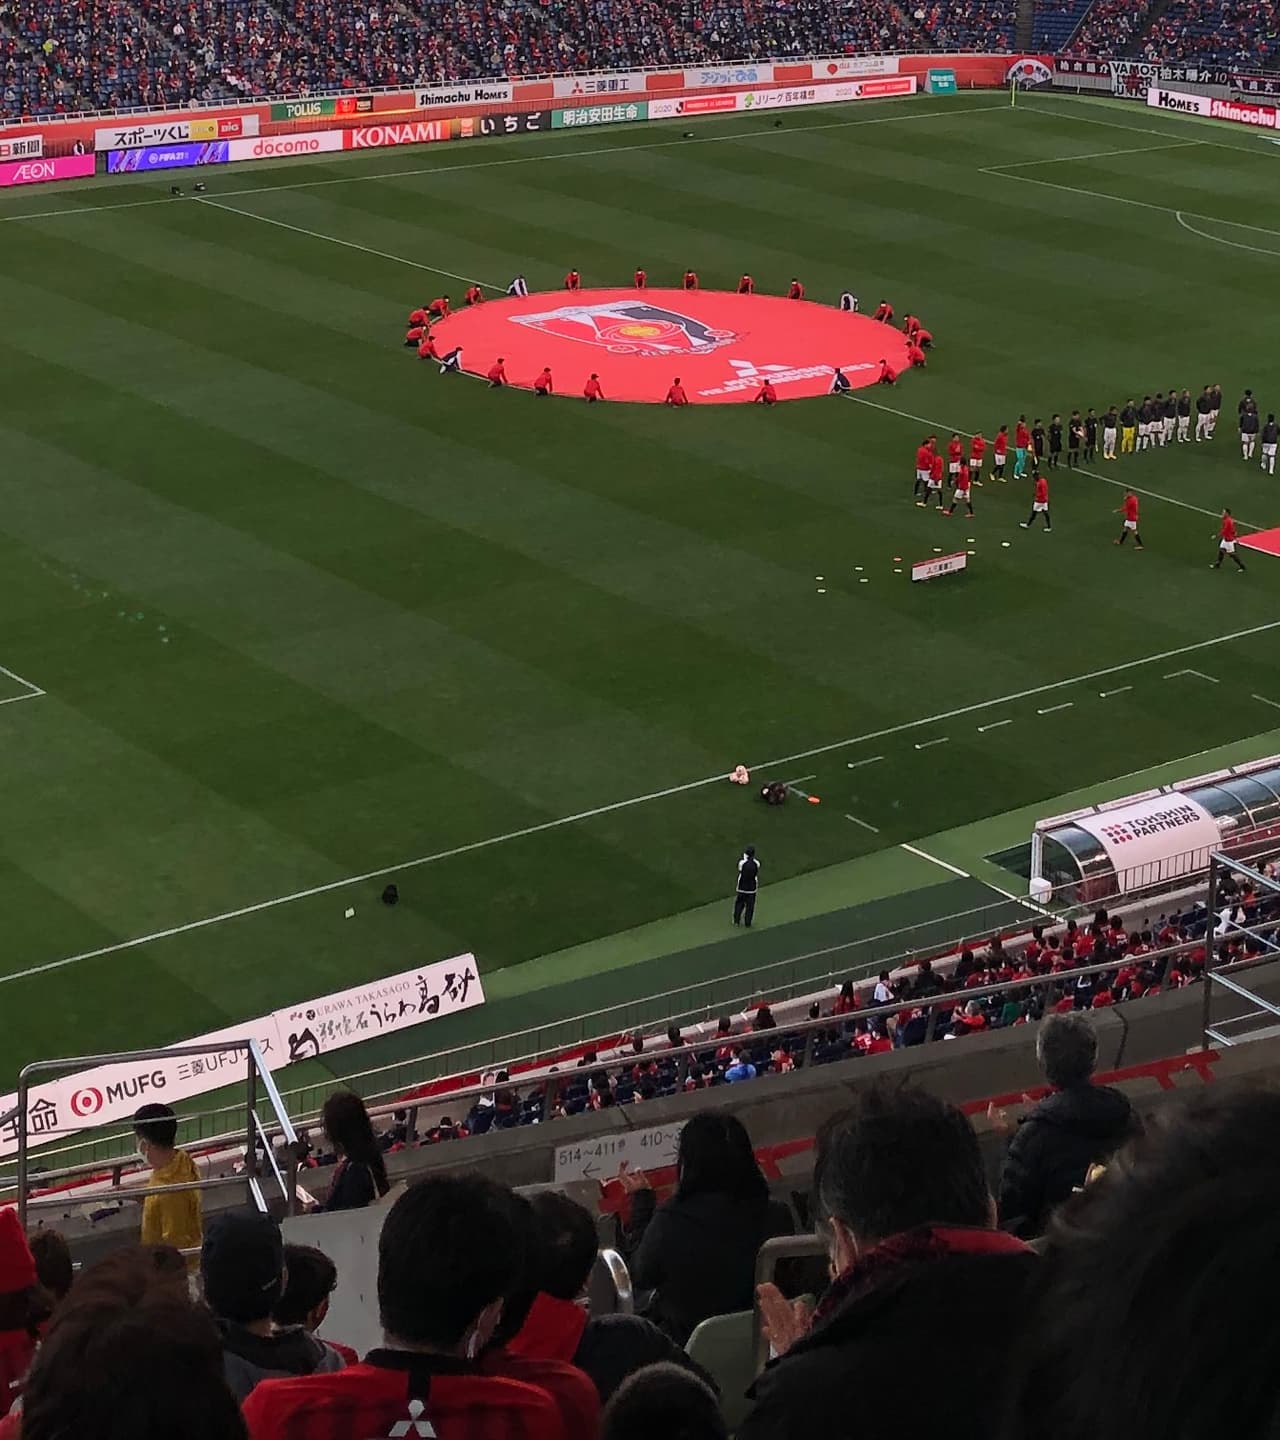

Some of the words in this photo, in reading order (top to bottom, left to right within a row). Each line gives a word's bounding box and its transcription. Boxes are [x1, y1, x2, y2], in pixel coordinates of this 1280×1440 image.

[1111, 62, 1158, 77] VAMOS
[1215, 71, 1227, 84] 10
[584, 77, 630, 93] 三菱重工
[420, 91, 471, 106] Shimachu
[286, 102, 322, 118] POLUS
[562, 104, 638, 125] 明治安田生命
[1210, 100, 1276, 127] Shimachu
[480, 112, 542, 134] いちご
[352, 122, 442, 149] KONAMI
[253, 138, 320, 156] docomo
[1126, 804, 1192, 830] TOHSHIN
[1132, 812, 1200, 839] PARTNERS
[316, 998, 353, 1018] URAWA
[355, 981, 410, 1005] TAKASAGO
[106, 1070, 167, 1104] MUFG
